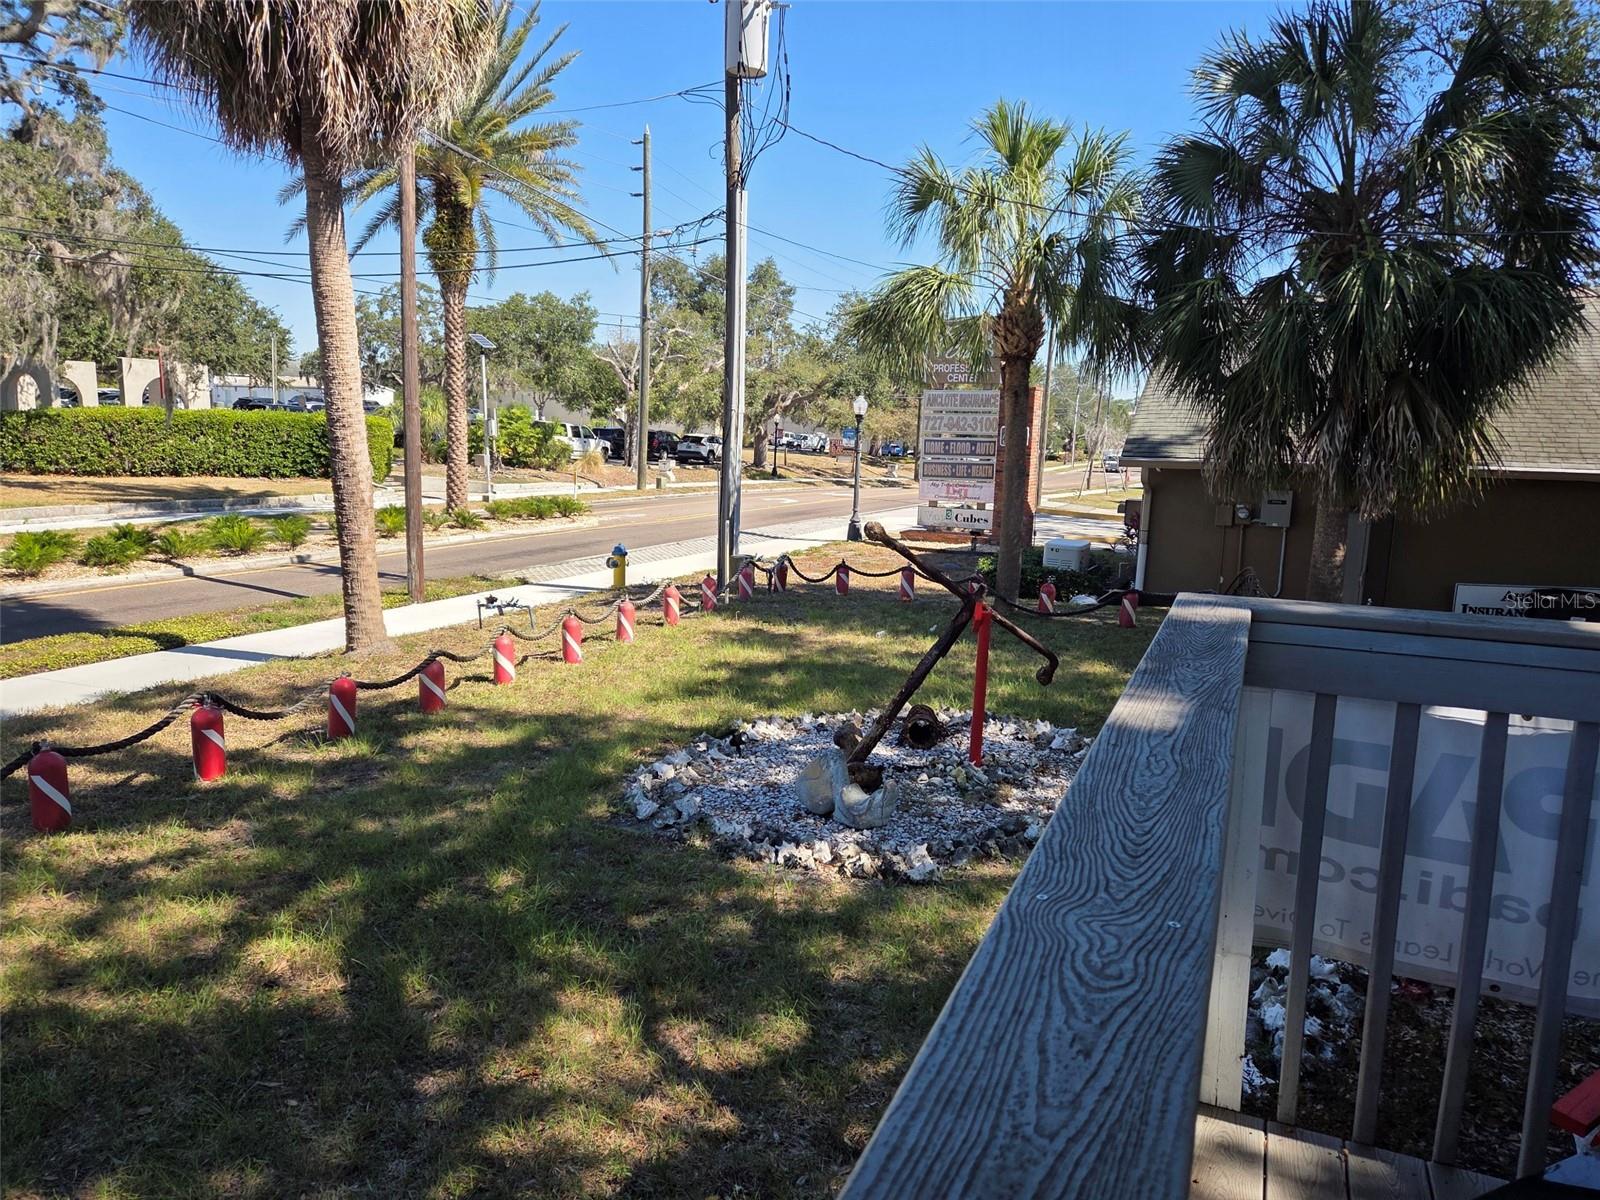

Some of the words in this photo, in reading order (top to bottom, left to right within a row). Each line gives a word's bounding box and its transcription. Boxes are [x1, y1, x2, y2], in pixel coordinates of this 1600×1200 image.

[926, 393, 958, 407] ANCLOTE
[959, 393, 999, 408] INSURANCE
[925, 441, 945, 454] HOME
[950, 441, 971, 454] FLOOD
[976, 442, 995, 455] AUTO
[923, 463, 952, 476] BUSINESS
[956, 464, 967, 477] LIFE
[971, 465, 993, 478] HEALTH
[954, 513, 989, 524] Cubes
